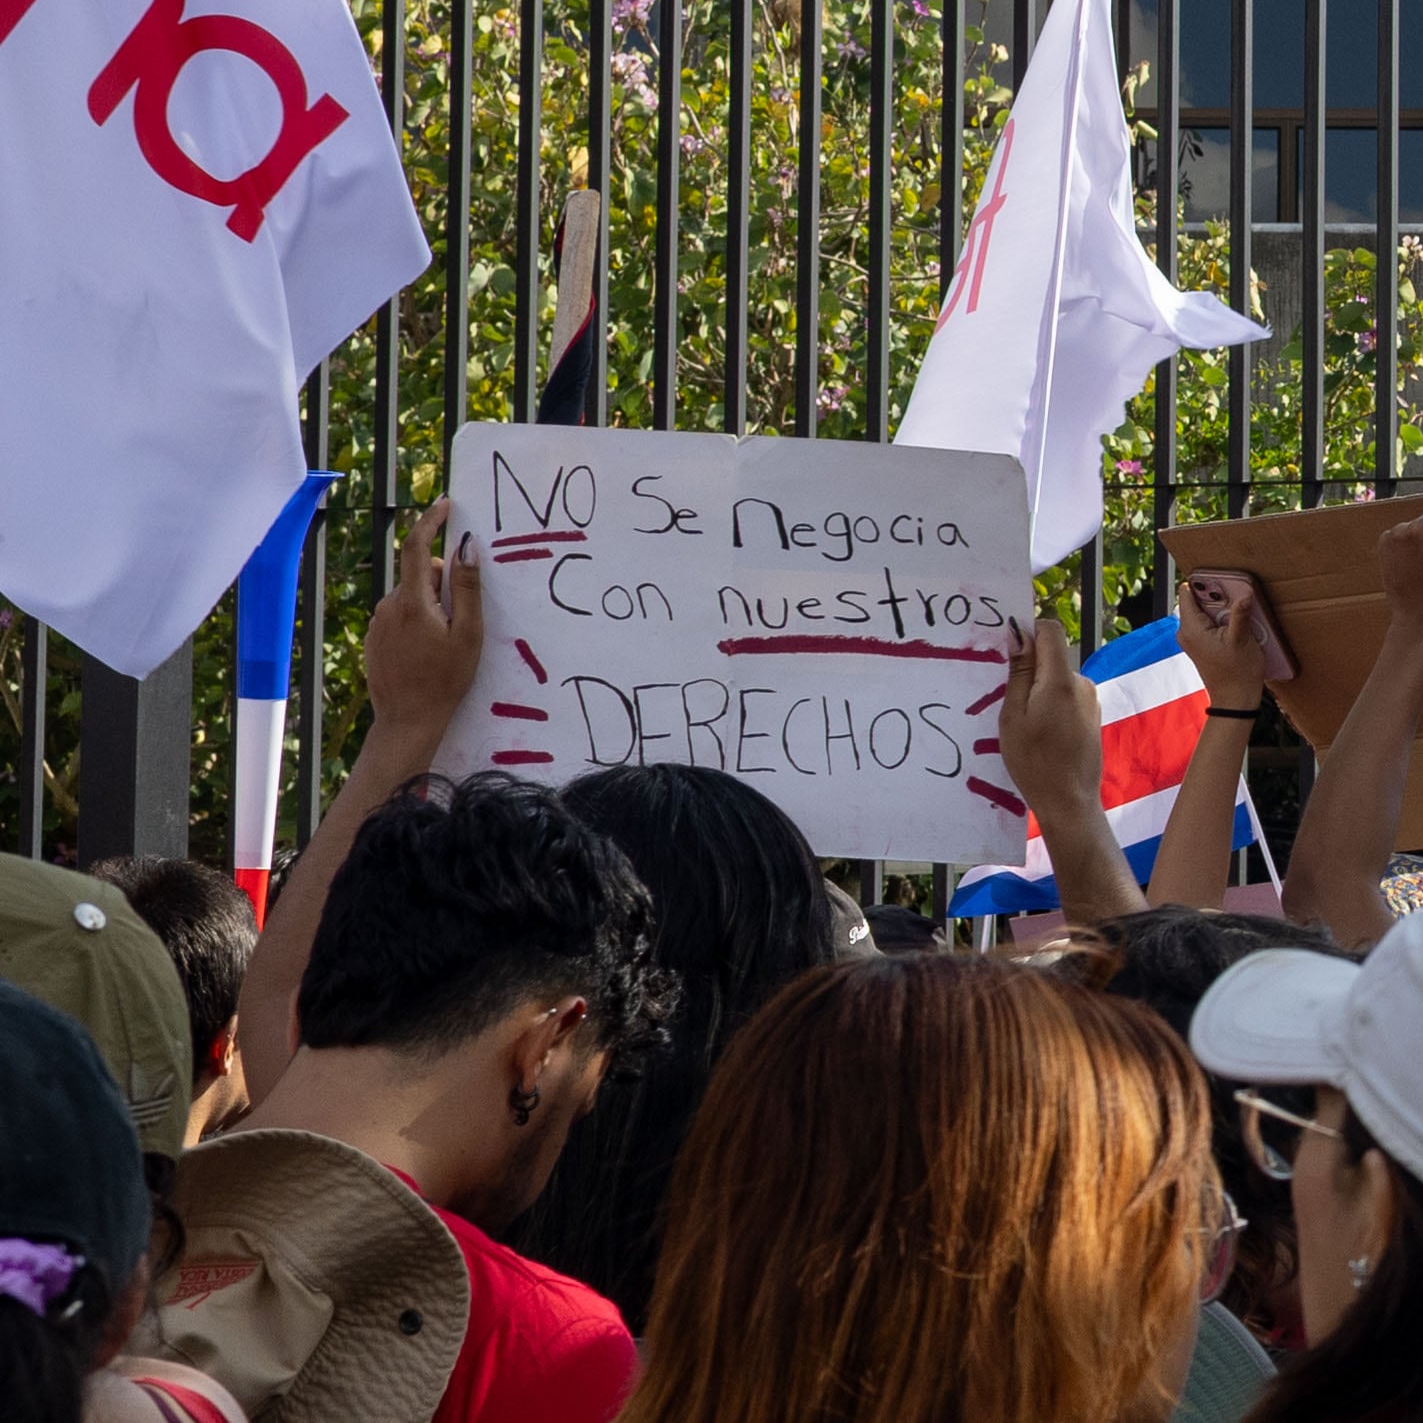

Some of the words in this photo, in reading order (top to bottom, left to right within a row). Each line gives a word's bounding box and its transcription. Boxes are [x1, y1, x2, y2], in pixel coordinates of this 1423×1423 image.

[492, 450, 597, 533] NO
[632, 475, 704, 535] Se
[548, 552, 674, 622] Con
[719, 566, 1006, 639] nuestros
[561, 674, 963, 779] DERECHOS
